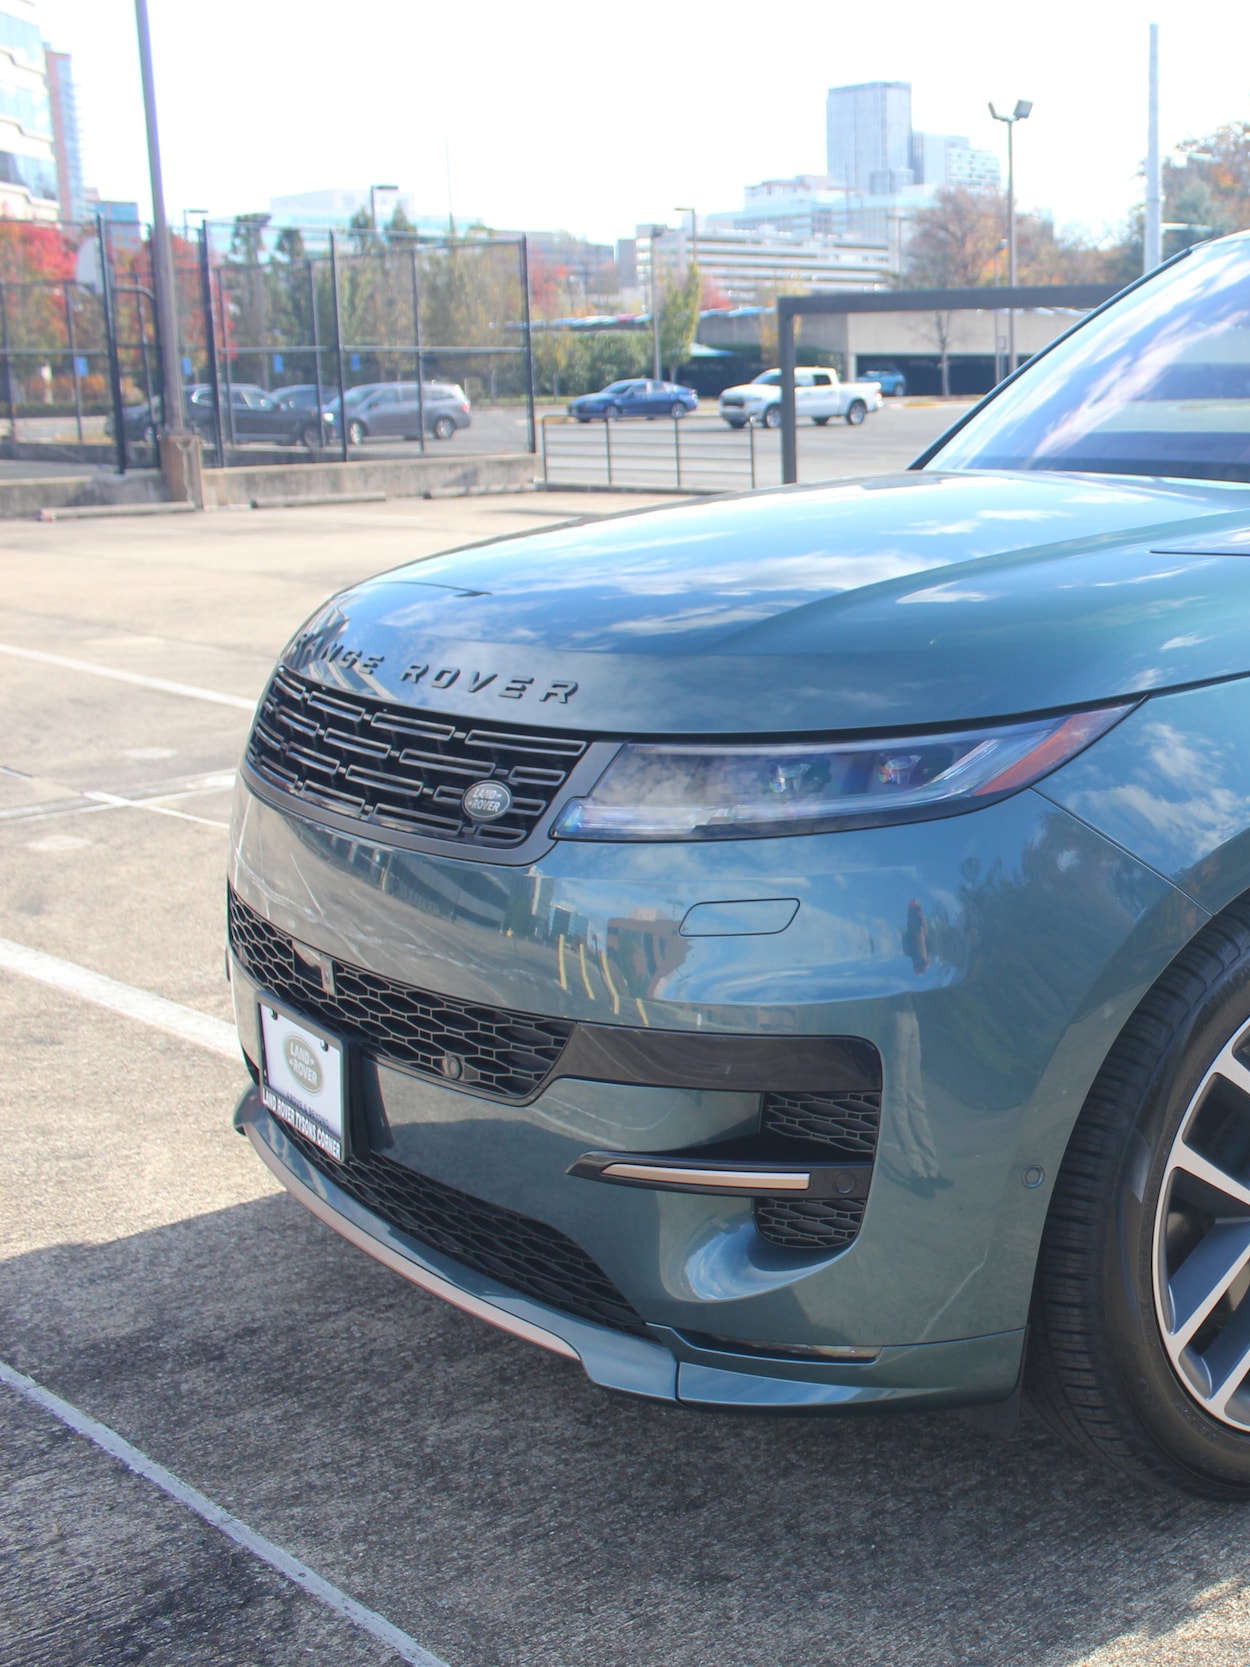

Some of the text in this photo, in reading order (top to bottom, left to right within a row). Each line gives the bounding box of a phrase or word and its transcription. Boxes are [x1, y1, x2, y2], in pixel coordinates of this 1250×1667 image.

[296, 632, 579, 704] RANGE ROVER
[471, 799, 501, 812] ROVER
[472, 788, 497, 800] LAND
[290, 1041, 310, 1065] LAND
[293, 1058, 318, 1087] ROVER
[262, 1087, 341, 1161] LAND ROVER TYSONS CORNER
